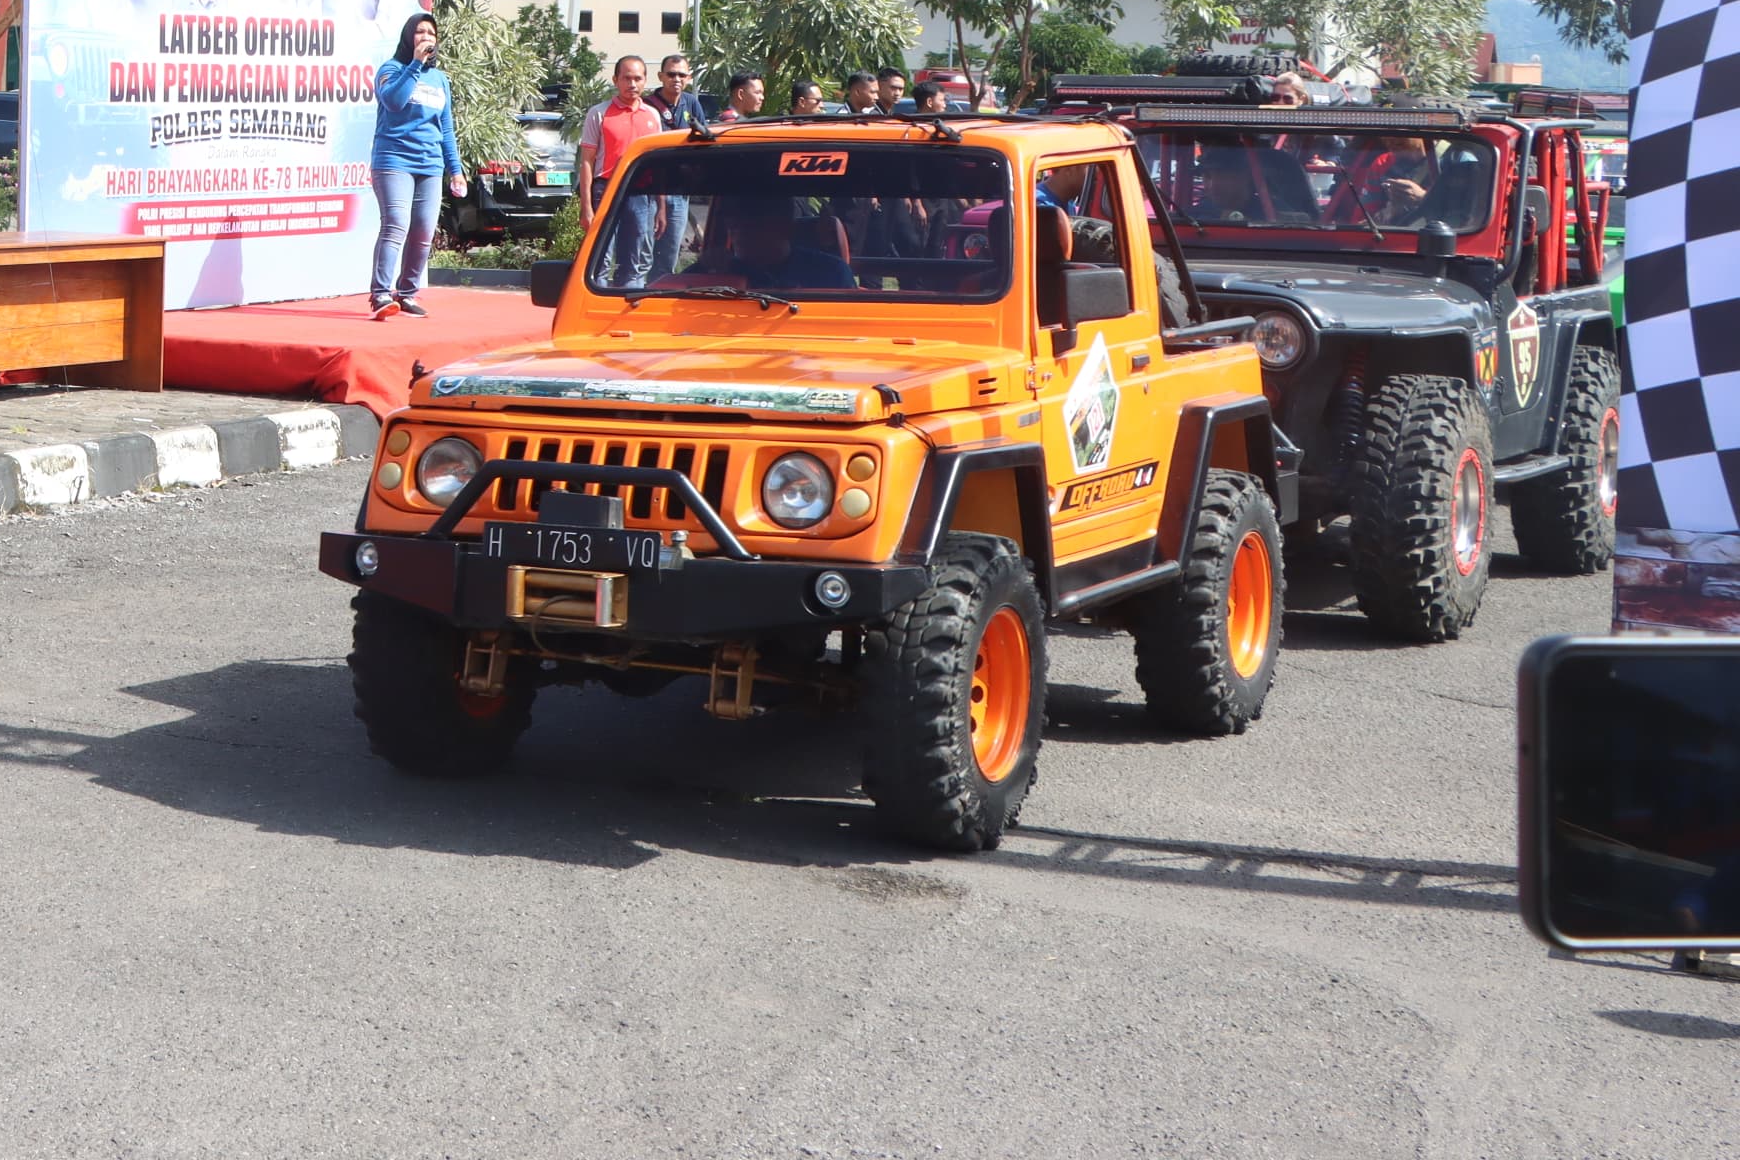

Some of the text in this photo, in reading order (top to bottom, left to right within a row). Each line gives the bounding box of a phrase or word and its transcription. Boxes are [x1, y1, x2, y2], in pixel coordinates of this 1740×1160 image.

[159, 14, 335, 58] LATBER OFFROAD
[109, 61, 157, 104] DAN
[163, 63, 290, 104] PEMBAGIAN
[295, 64, 374, 103] BANSOS
[150, 108, 328, 146] POLRES SEMARANG
[106, 163, 373, 196] HARI BHAYANGKARA KE-78 TAHUN 2024
[783, 155, 844, 173] KTM
[1069, 469, 1137, 513] OFFROAD
[488, 527, 655, 568] H 1753 VQ
